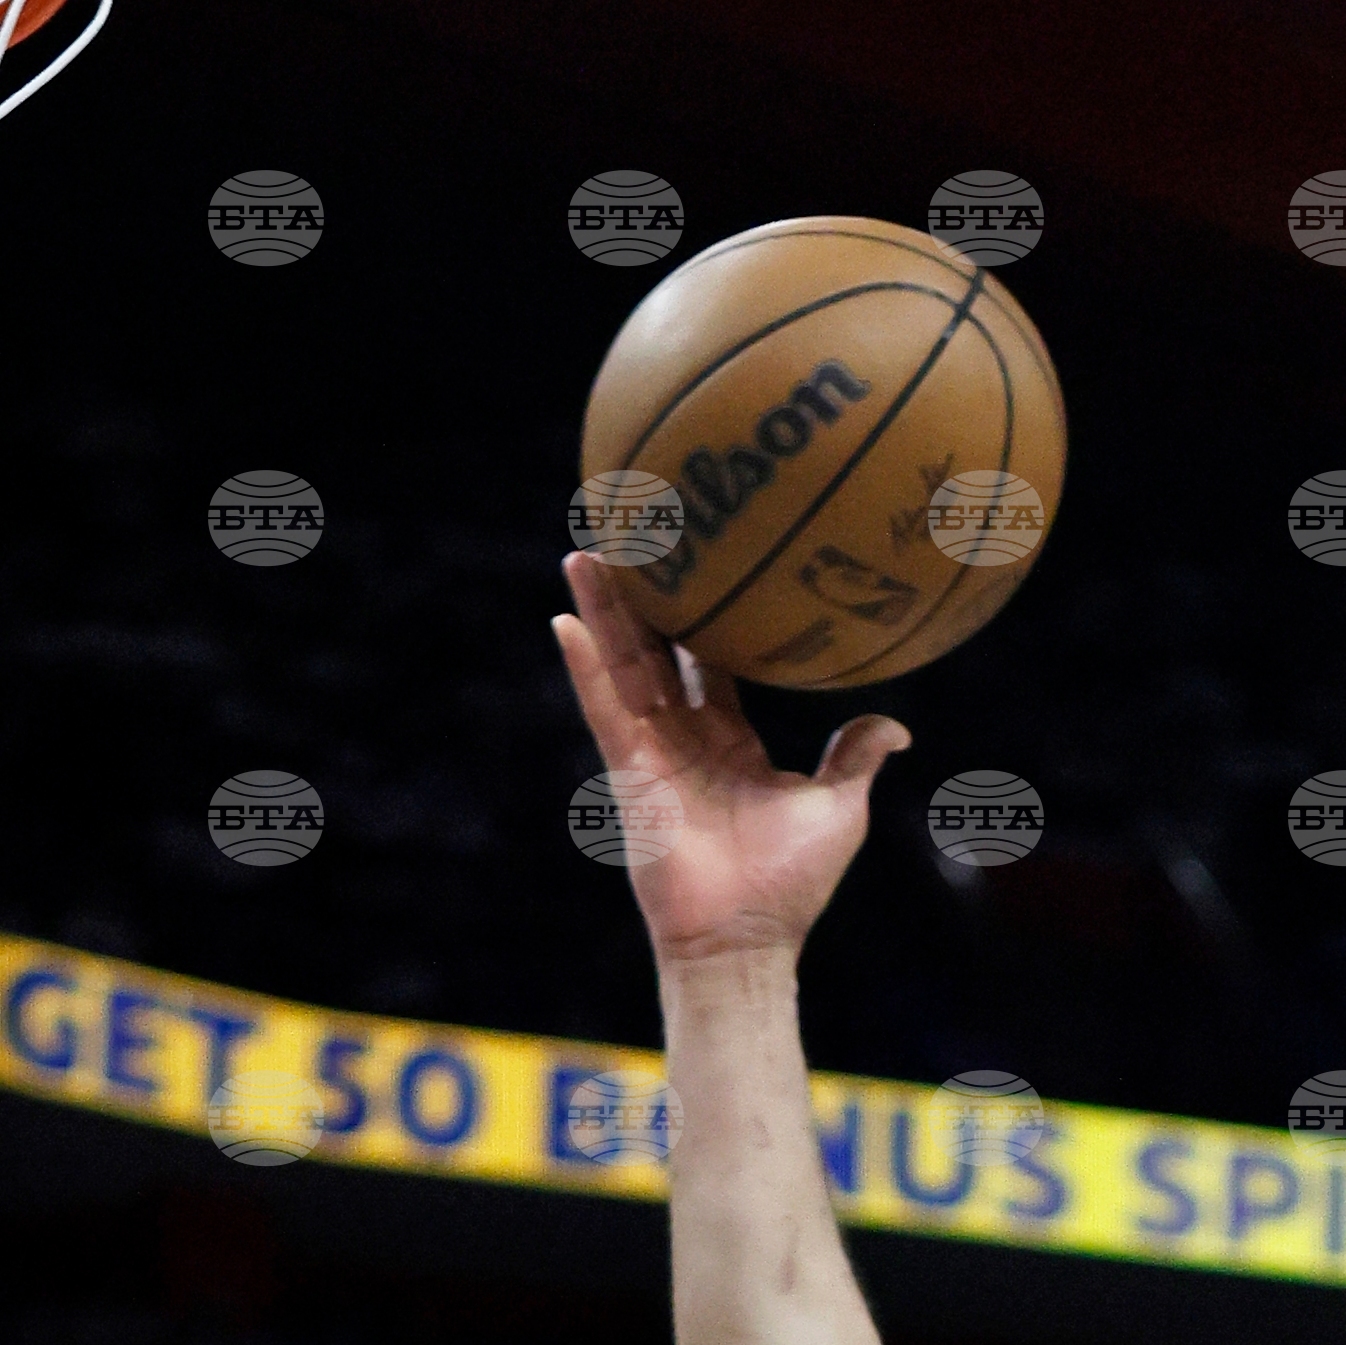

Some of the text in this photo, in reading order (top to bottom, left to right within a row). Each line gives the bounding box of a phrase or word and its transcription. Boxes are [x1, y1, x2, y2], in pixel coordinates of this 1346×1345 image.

[7, 969, 258, 1109] GET
[317, 1034, 479, 1147] 50
[550, 1064, 1070, 1220] BNUS
